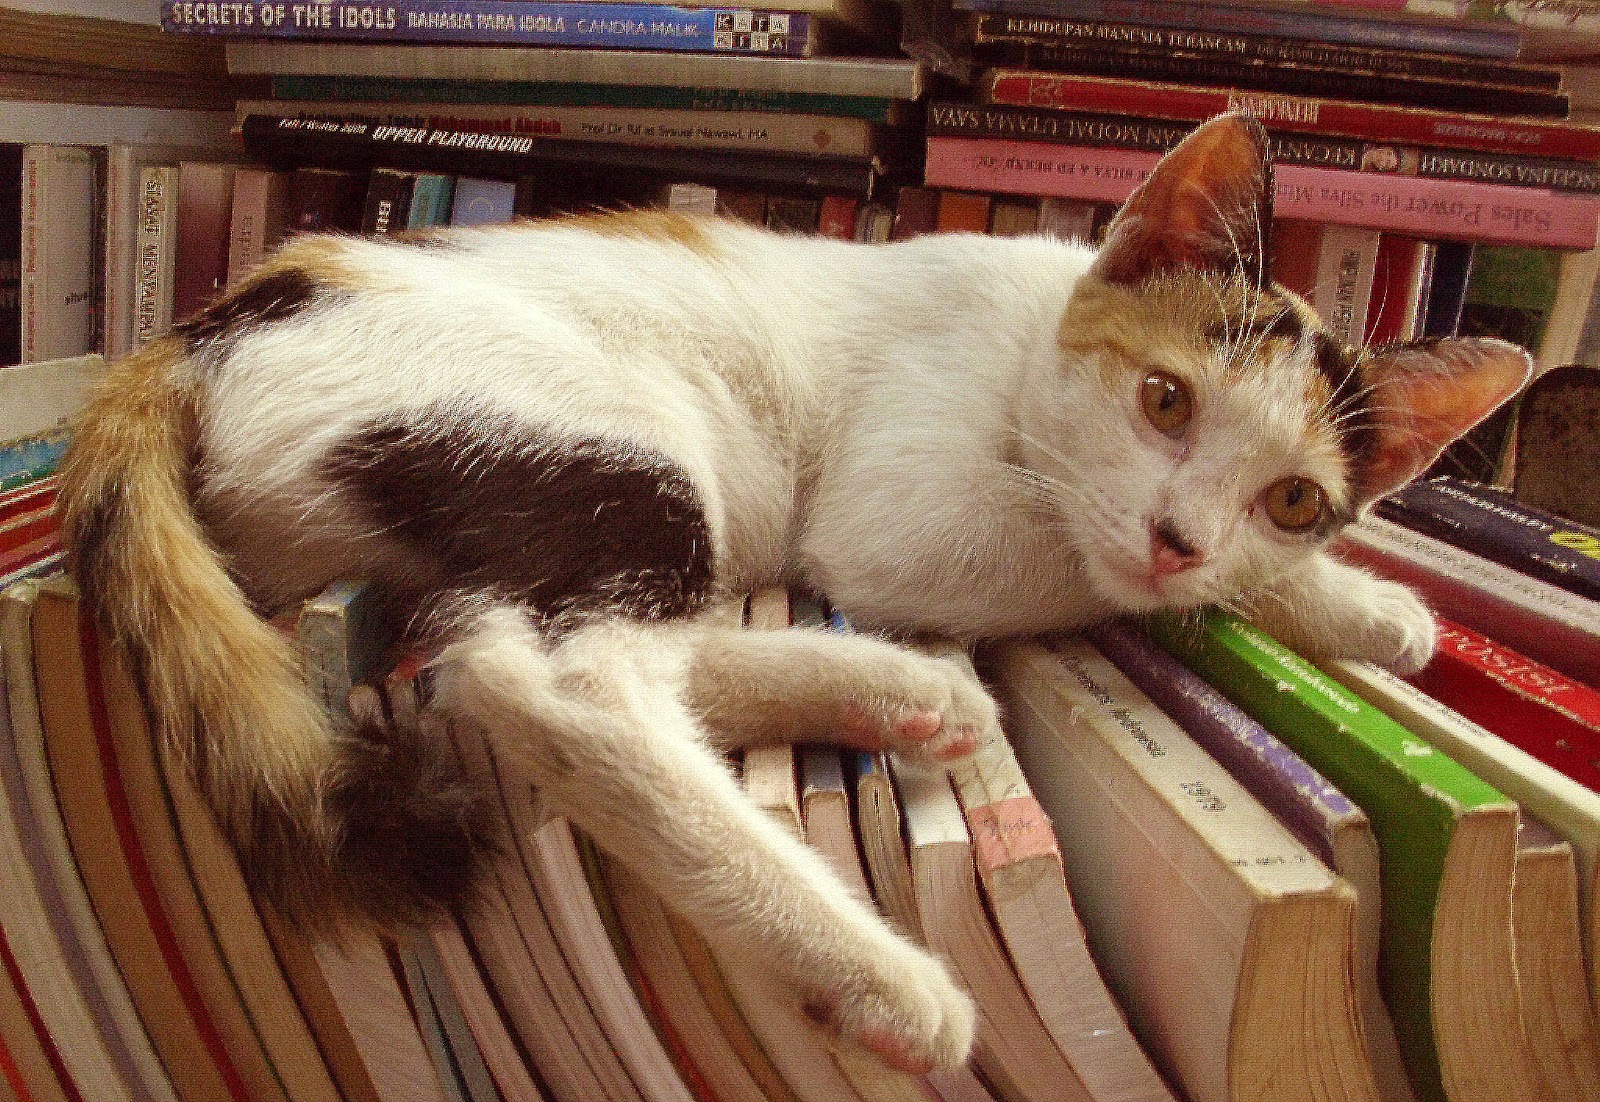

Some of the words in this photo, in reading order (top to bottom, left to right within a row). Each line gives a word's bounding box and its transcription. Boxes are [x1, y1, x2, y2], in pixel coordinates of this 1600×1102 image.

[171, 1, 254, 26] SECRETS
[260, 3, 286, 27] OF
[292, 4, 332, 29] THE
[339, 6, 396, 30] IDOLS
[407, 11, 475, 30] RAHASIA
[476, 14, 516, 32] PARA
[519, 16, 566, 33] IDOLA
[577, 18, 648, 36] CANDRA
[650, 20, 701, 38] MALIK
[1006, 17, 1094, 38] KEHIDUPAN
[1096, 25, 1163, 46] MANUSIA
[1167, 34, 1247, 54] TERANCAM
[932, 106, 980, 130] SAYA
[984, 110, 1058, 137] UTAMA
[1068, 119, 1142, 143] MODAL
[372, 126, 424, 147] UPPER
[427, 129, 534, 154] PLAYGROUND
[1421, 154, 1512, 180] SONDAKH
[1320, 187, 1365, 210] Silva
[1371, 190, 1400, 213] the
[1406, 194, 1484, 226] Power
[1492, 206, 1553, 233] Sales
